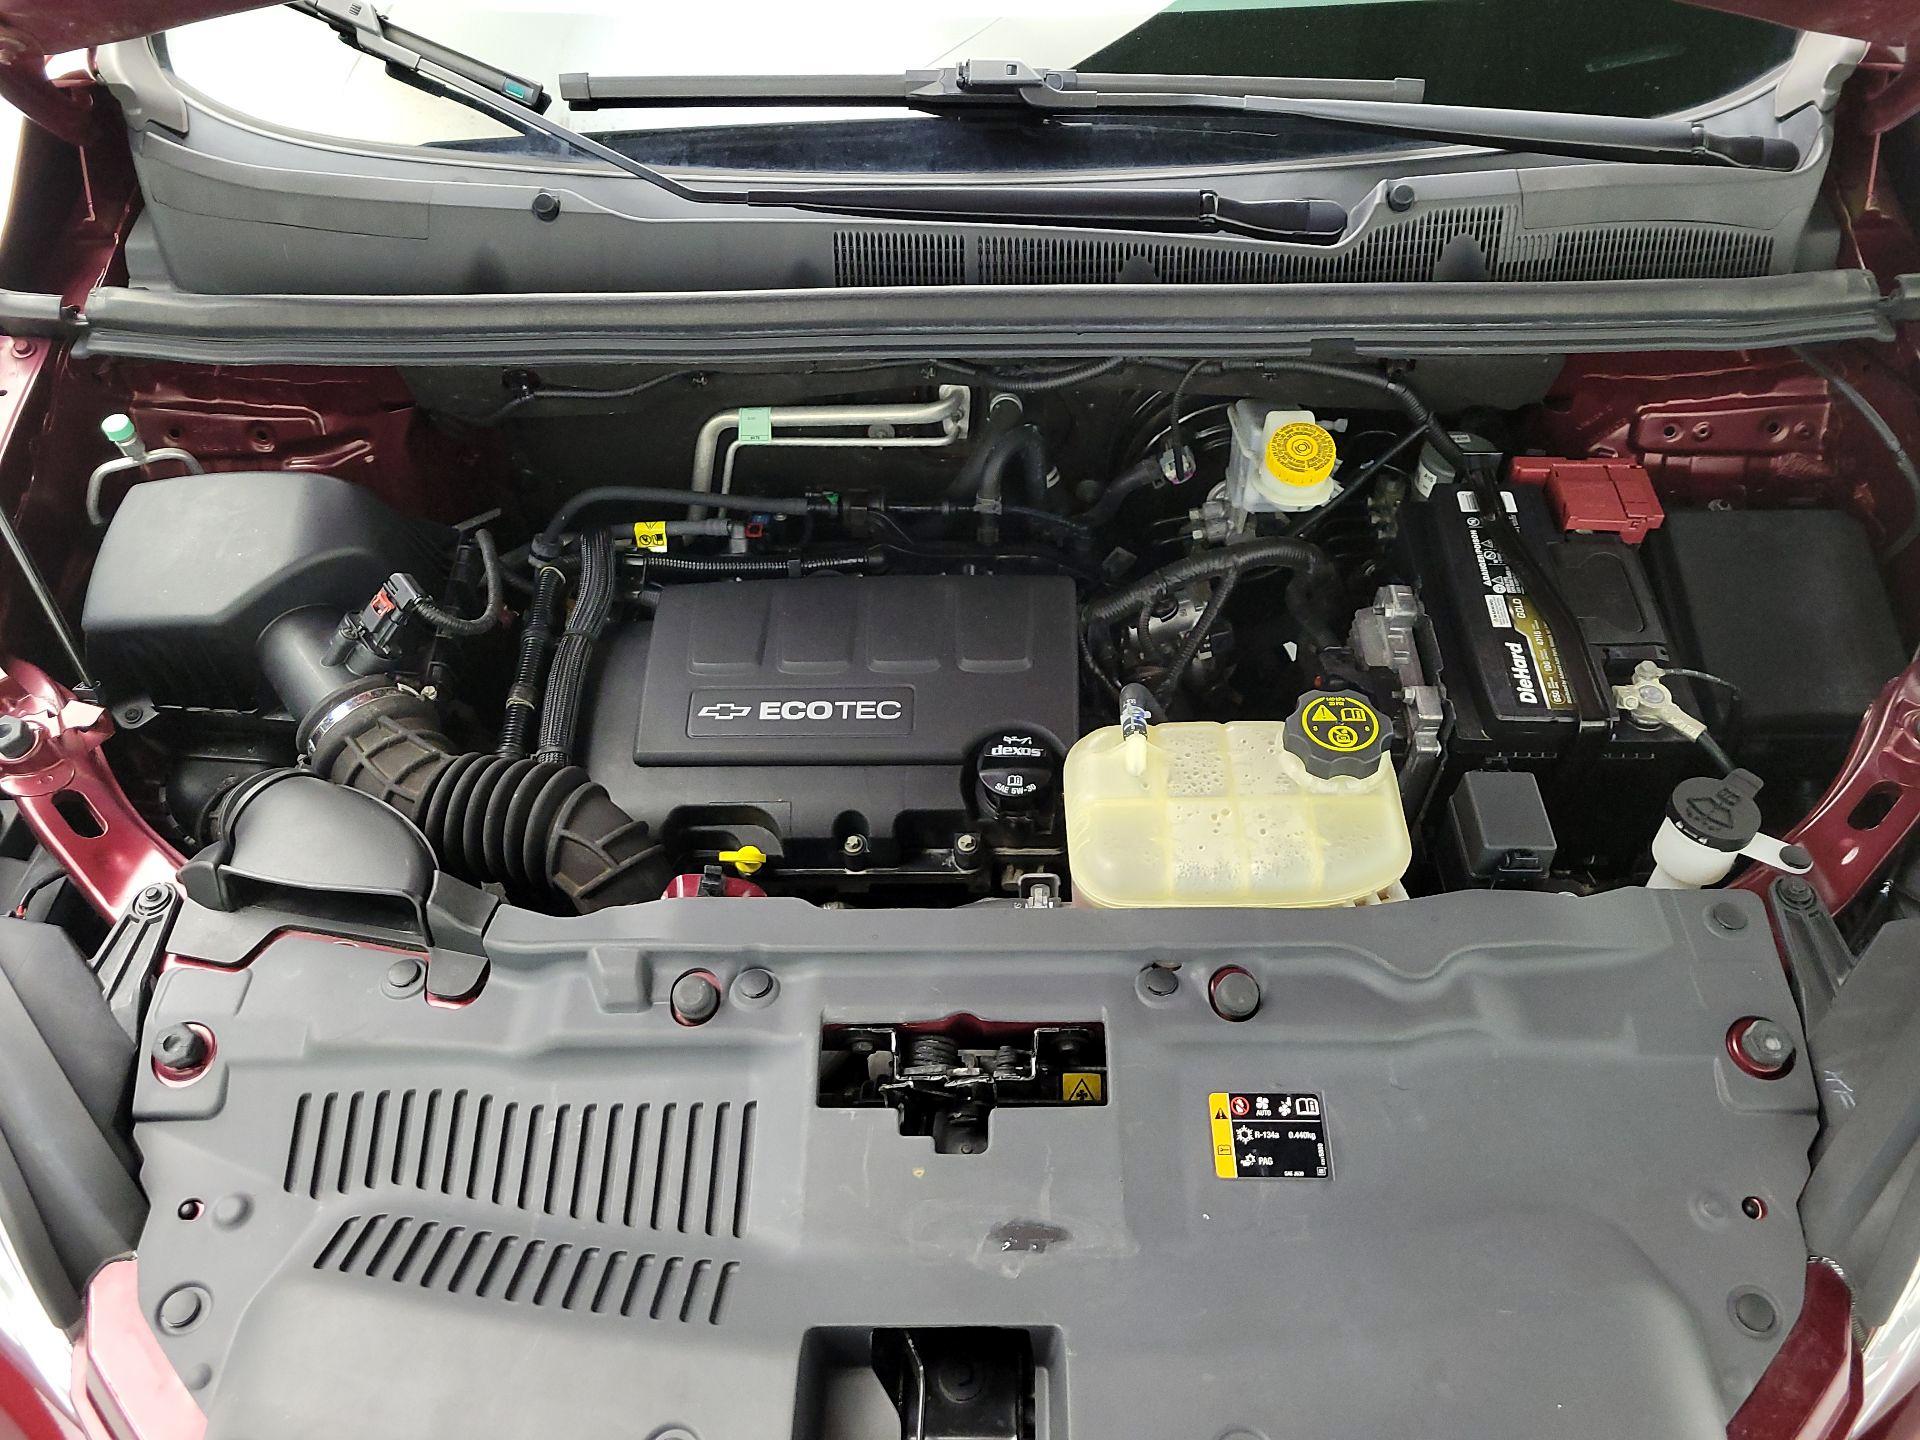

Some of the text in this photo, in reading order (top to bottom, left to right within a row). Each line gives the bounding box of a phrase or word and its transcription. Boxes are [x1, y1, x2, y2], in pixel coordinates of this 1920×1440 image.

[1512, 598, 1527, 619] GOLD
[1504, 641, 1538, 704] DieHard
[1551, 689, 1562, 703] 650
[758, 700, 902, 720] ECOTEC
[991, 745, 1043, 757] dexos
[994, 782, 1037, 795] SAE 5W-30
[1255, 1109, 1272, 1117] AUTO
[1254, 1130, 1317, 1141] R-134a 0.440kg
[1258, 1156, 1274, 1166] PAG
